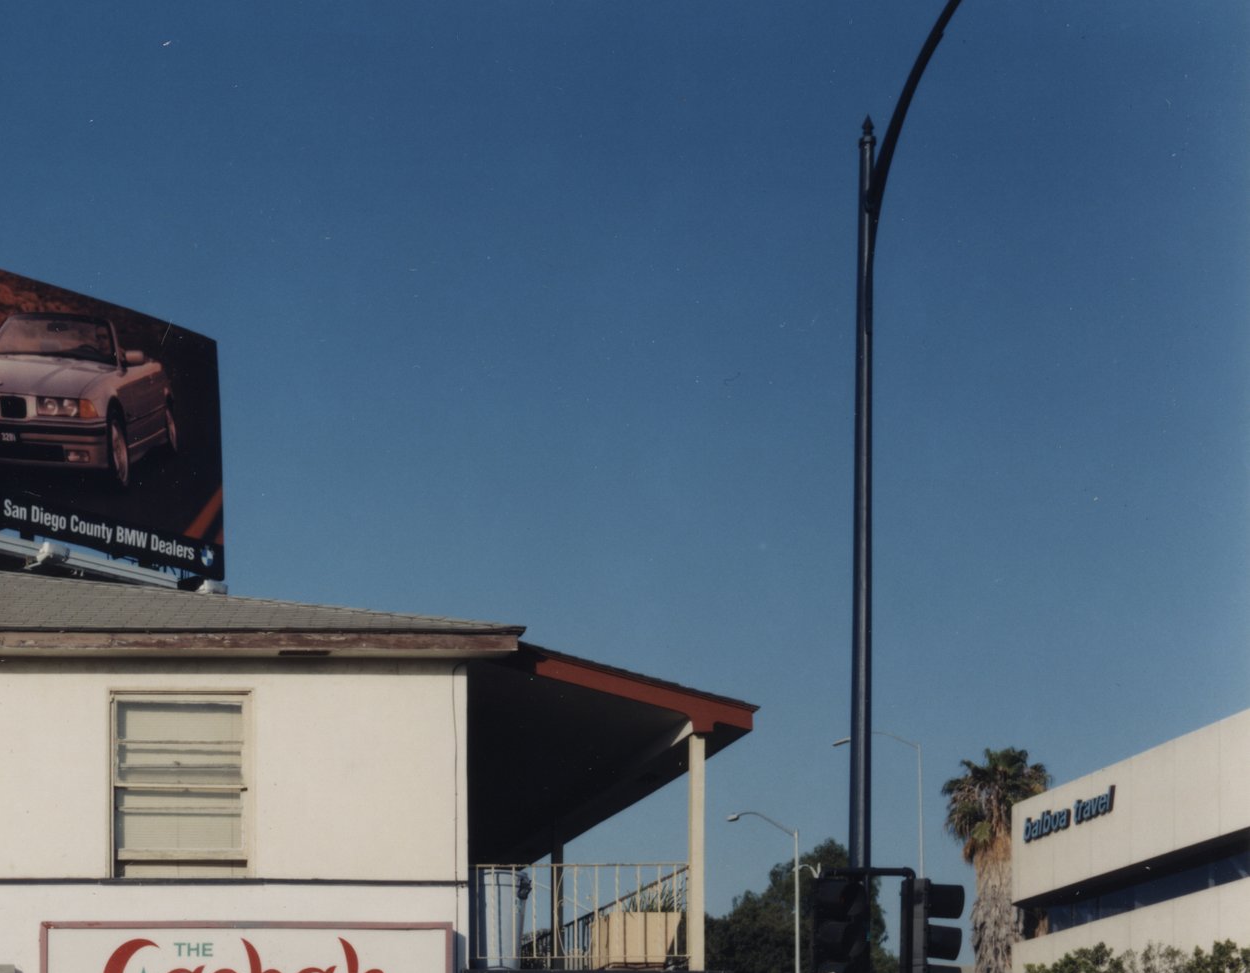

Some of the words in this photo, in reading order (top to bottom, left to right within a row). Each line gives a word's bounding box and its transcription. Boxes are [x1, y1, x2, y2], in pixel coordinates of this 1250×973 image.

[3, 499, 27, 520] San
[31, 505, 67, 530] Diego
[70, 515, 114, 543] County
[116, 526, 147, 549] BMW
[151, 535, 195, 560] Dealers
[1023, 808, 1071, 843] balboa
[1074, 785, 1116, 825] travel
[173, 942, 214, 957] THE
